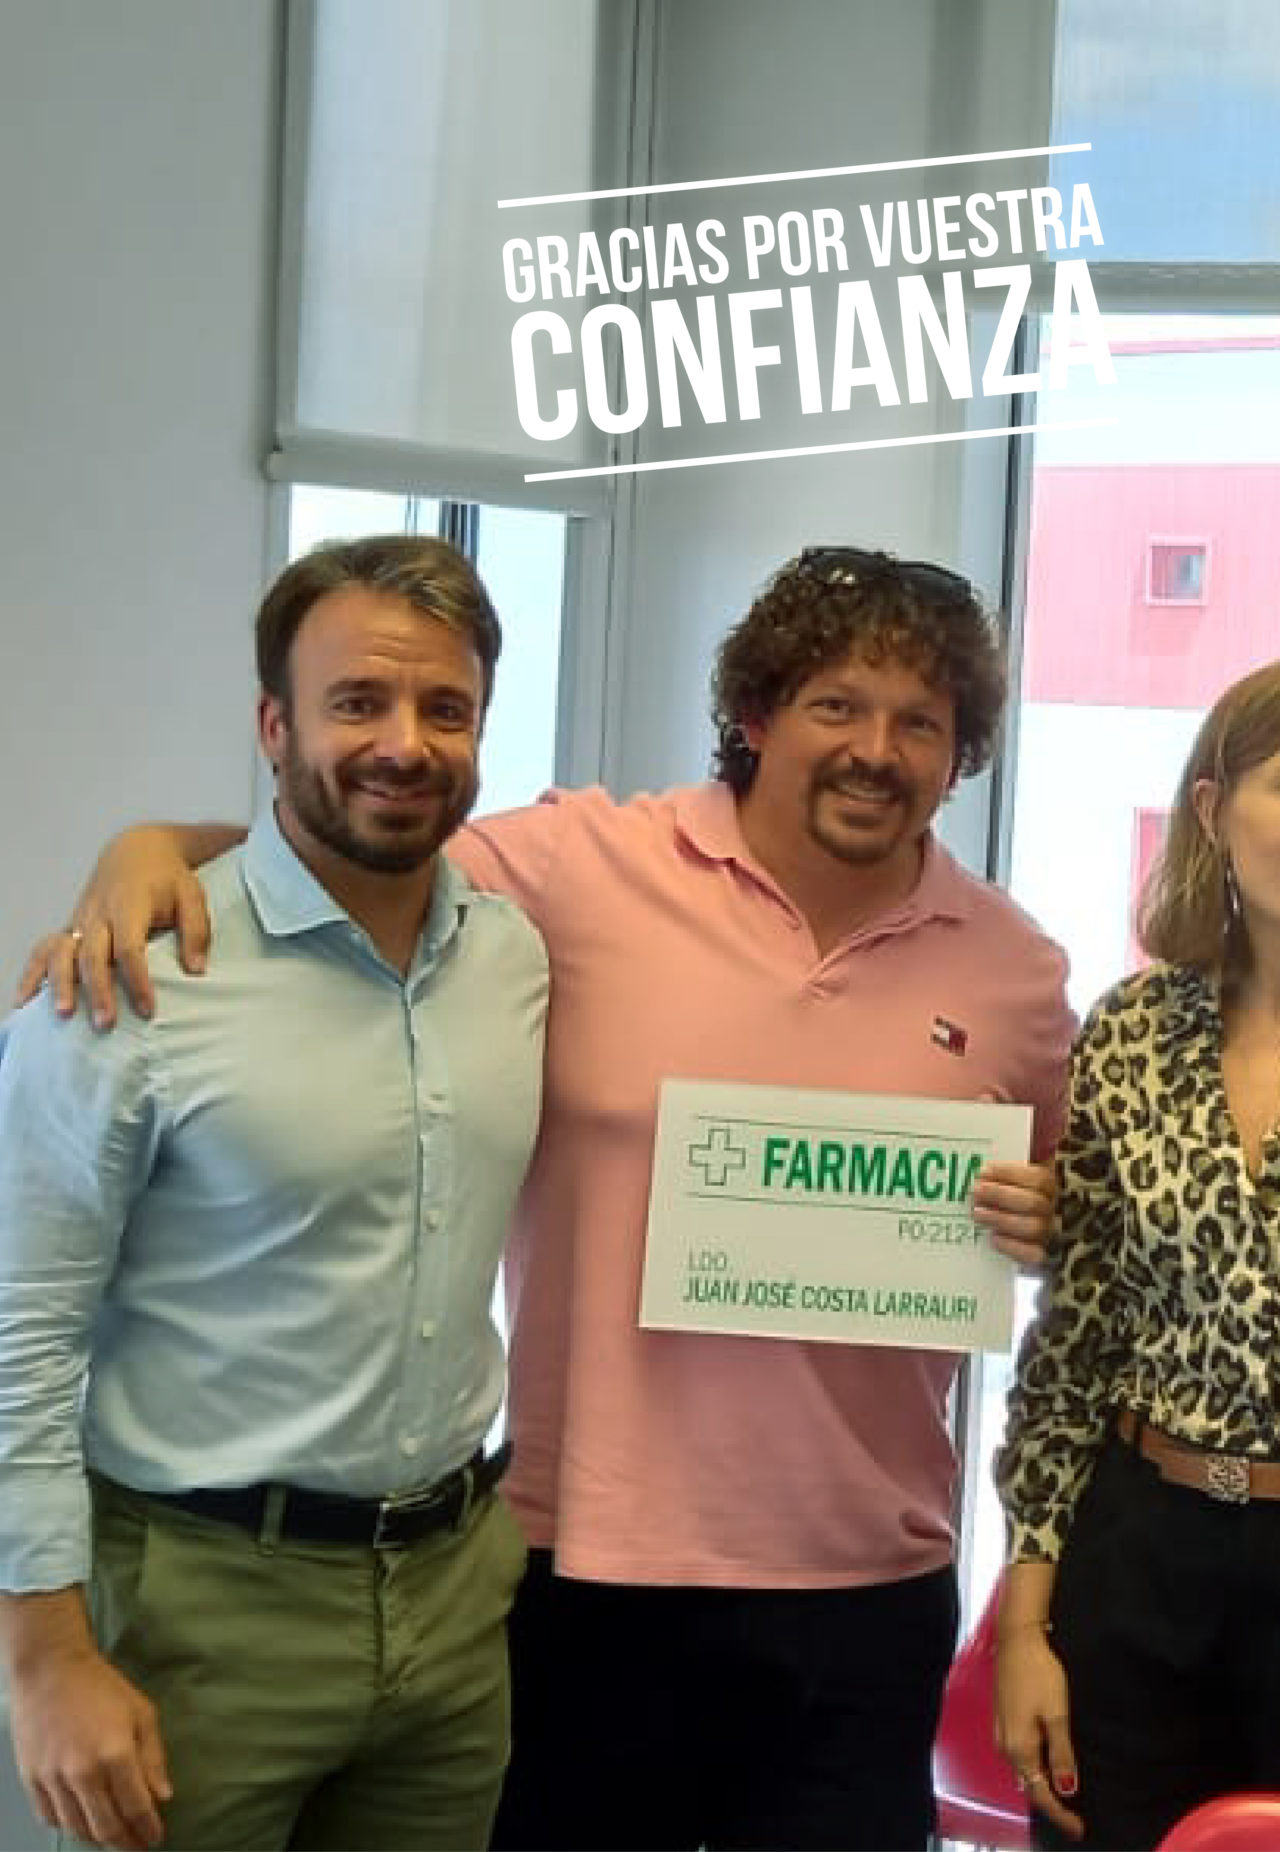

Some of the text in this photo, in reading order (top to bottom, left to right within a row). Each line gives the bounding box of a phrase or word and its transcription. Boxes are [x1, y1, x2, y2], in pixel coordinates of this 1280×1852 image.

[683, 1275, 740, 1305] JUAN
[800, 1284, 869, 1314] COSTA
[873, 1288, 978, 1322] LARRAURI
